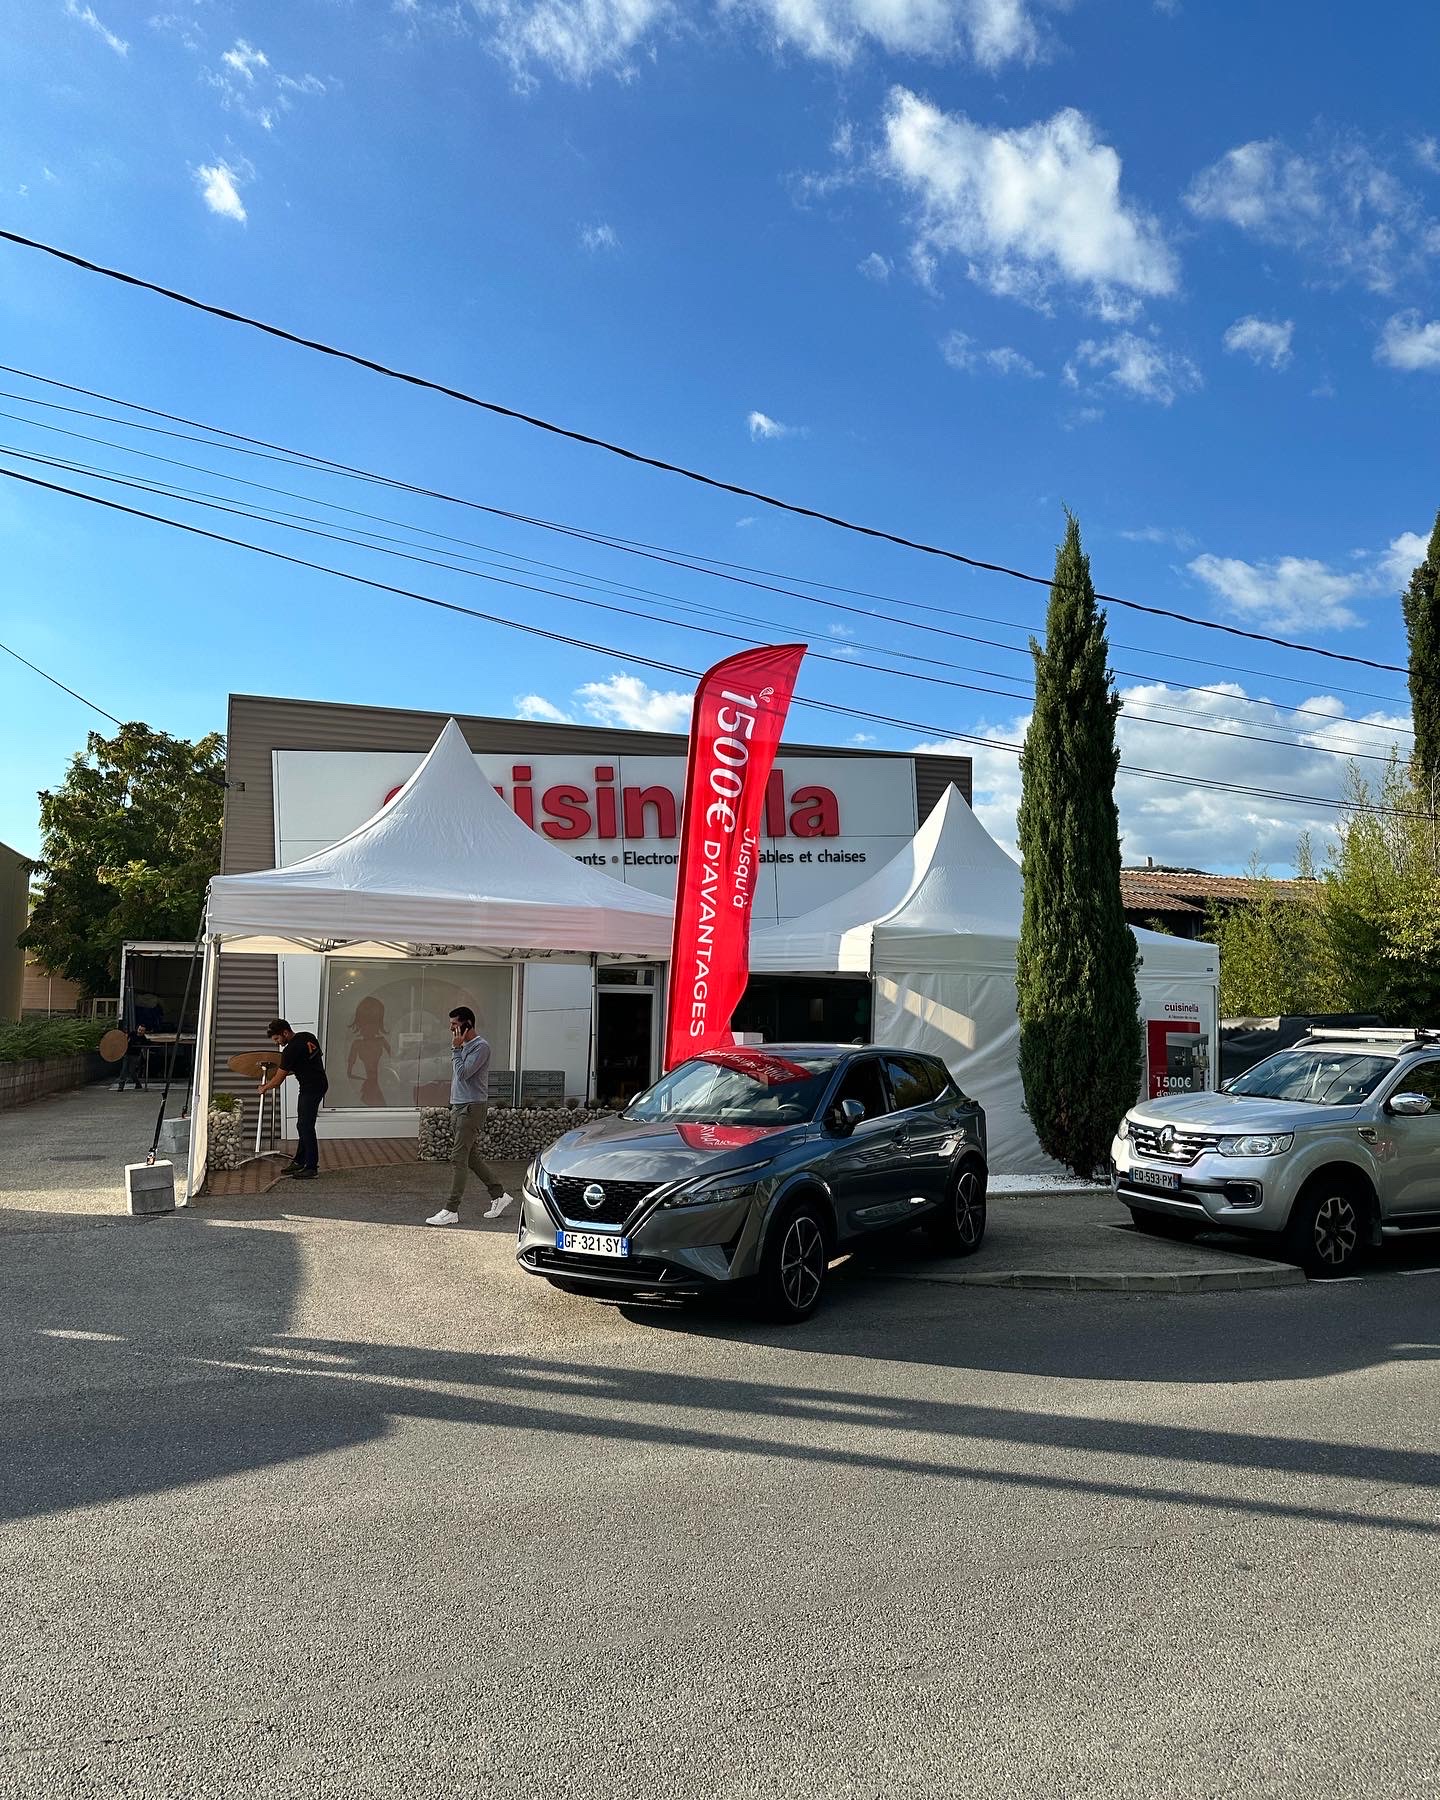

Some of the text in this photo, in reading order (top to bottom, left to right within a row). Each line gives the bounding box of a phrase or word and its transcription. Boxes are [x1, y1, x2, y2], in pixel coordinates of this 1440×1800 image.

[383, 765, 840, 839] isinla
[571, 852, 606, 866] ents
[758, 849, 795, 863] ables
[799, 850, 813, 863] et
[818, 848, 867, 863] chaises
[690, 690, 758, 1037] 1500€ D'AVANTAGES
[733, 828, 757, 908] Jusqu'à
[564, 1233, 620, 1253] GF-321-SY
